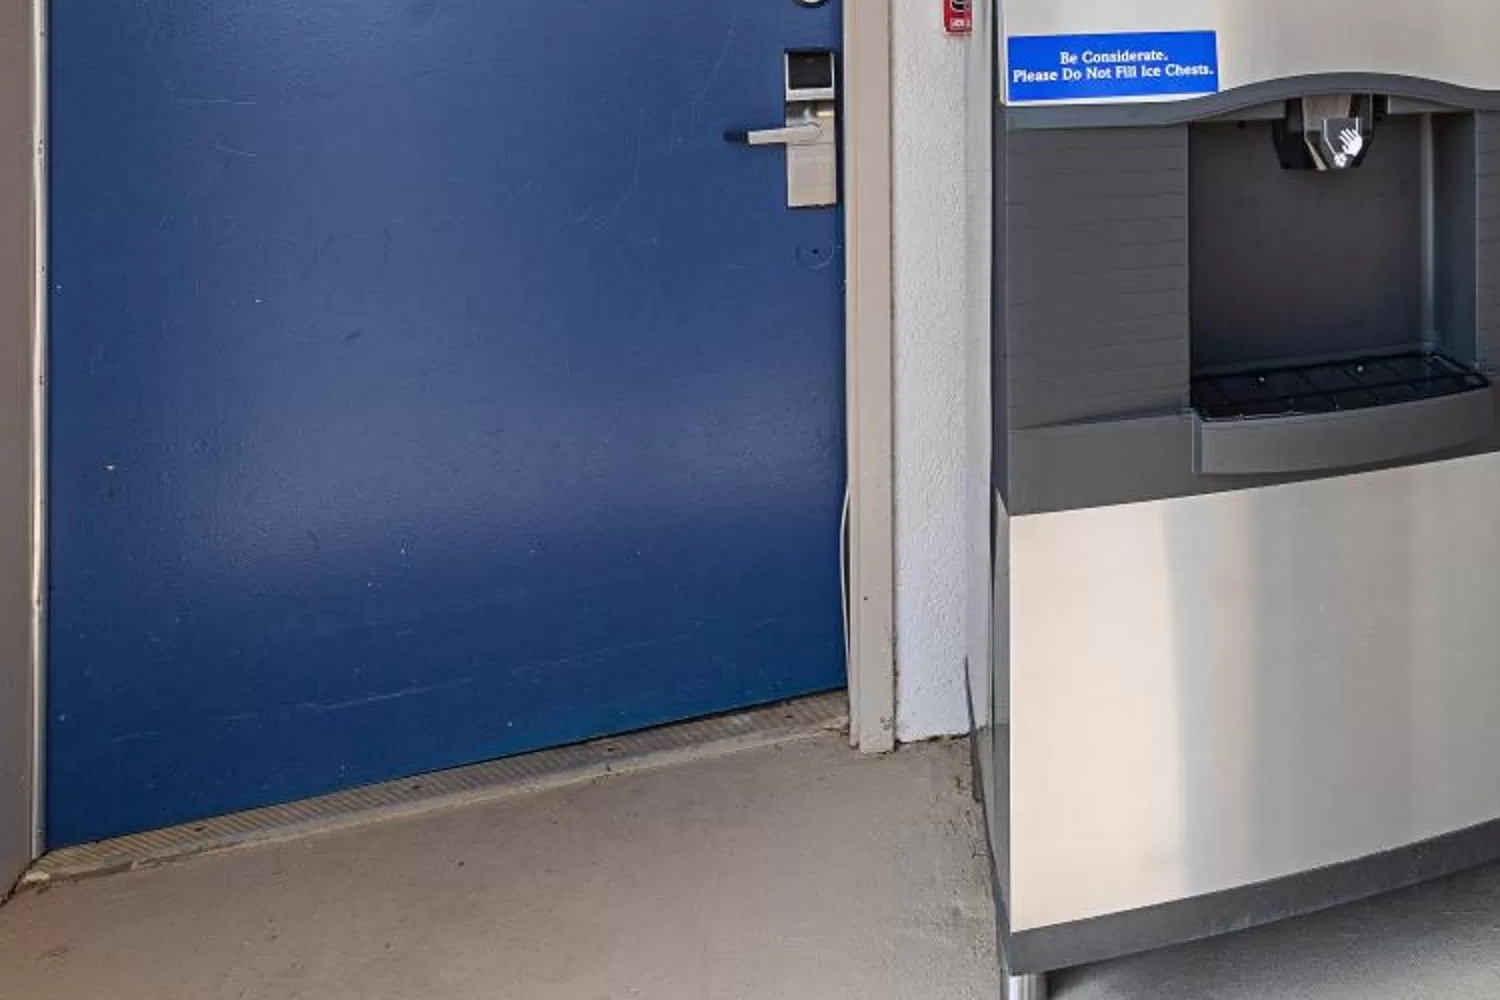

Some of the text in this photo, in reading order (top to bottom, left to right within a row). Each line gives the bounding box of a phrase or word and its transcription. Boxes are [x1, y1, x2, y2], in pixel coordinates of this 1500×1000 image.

[1060, 49, 1168, 64] Be Considerate.
[1012, 63, 1214, 82] Please Do Not Fill Ice Chests.
